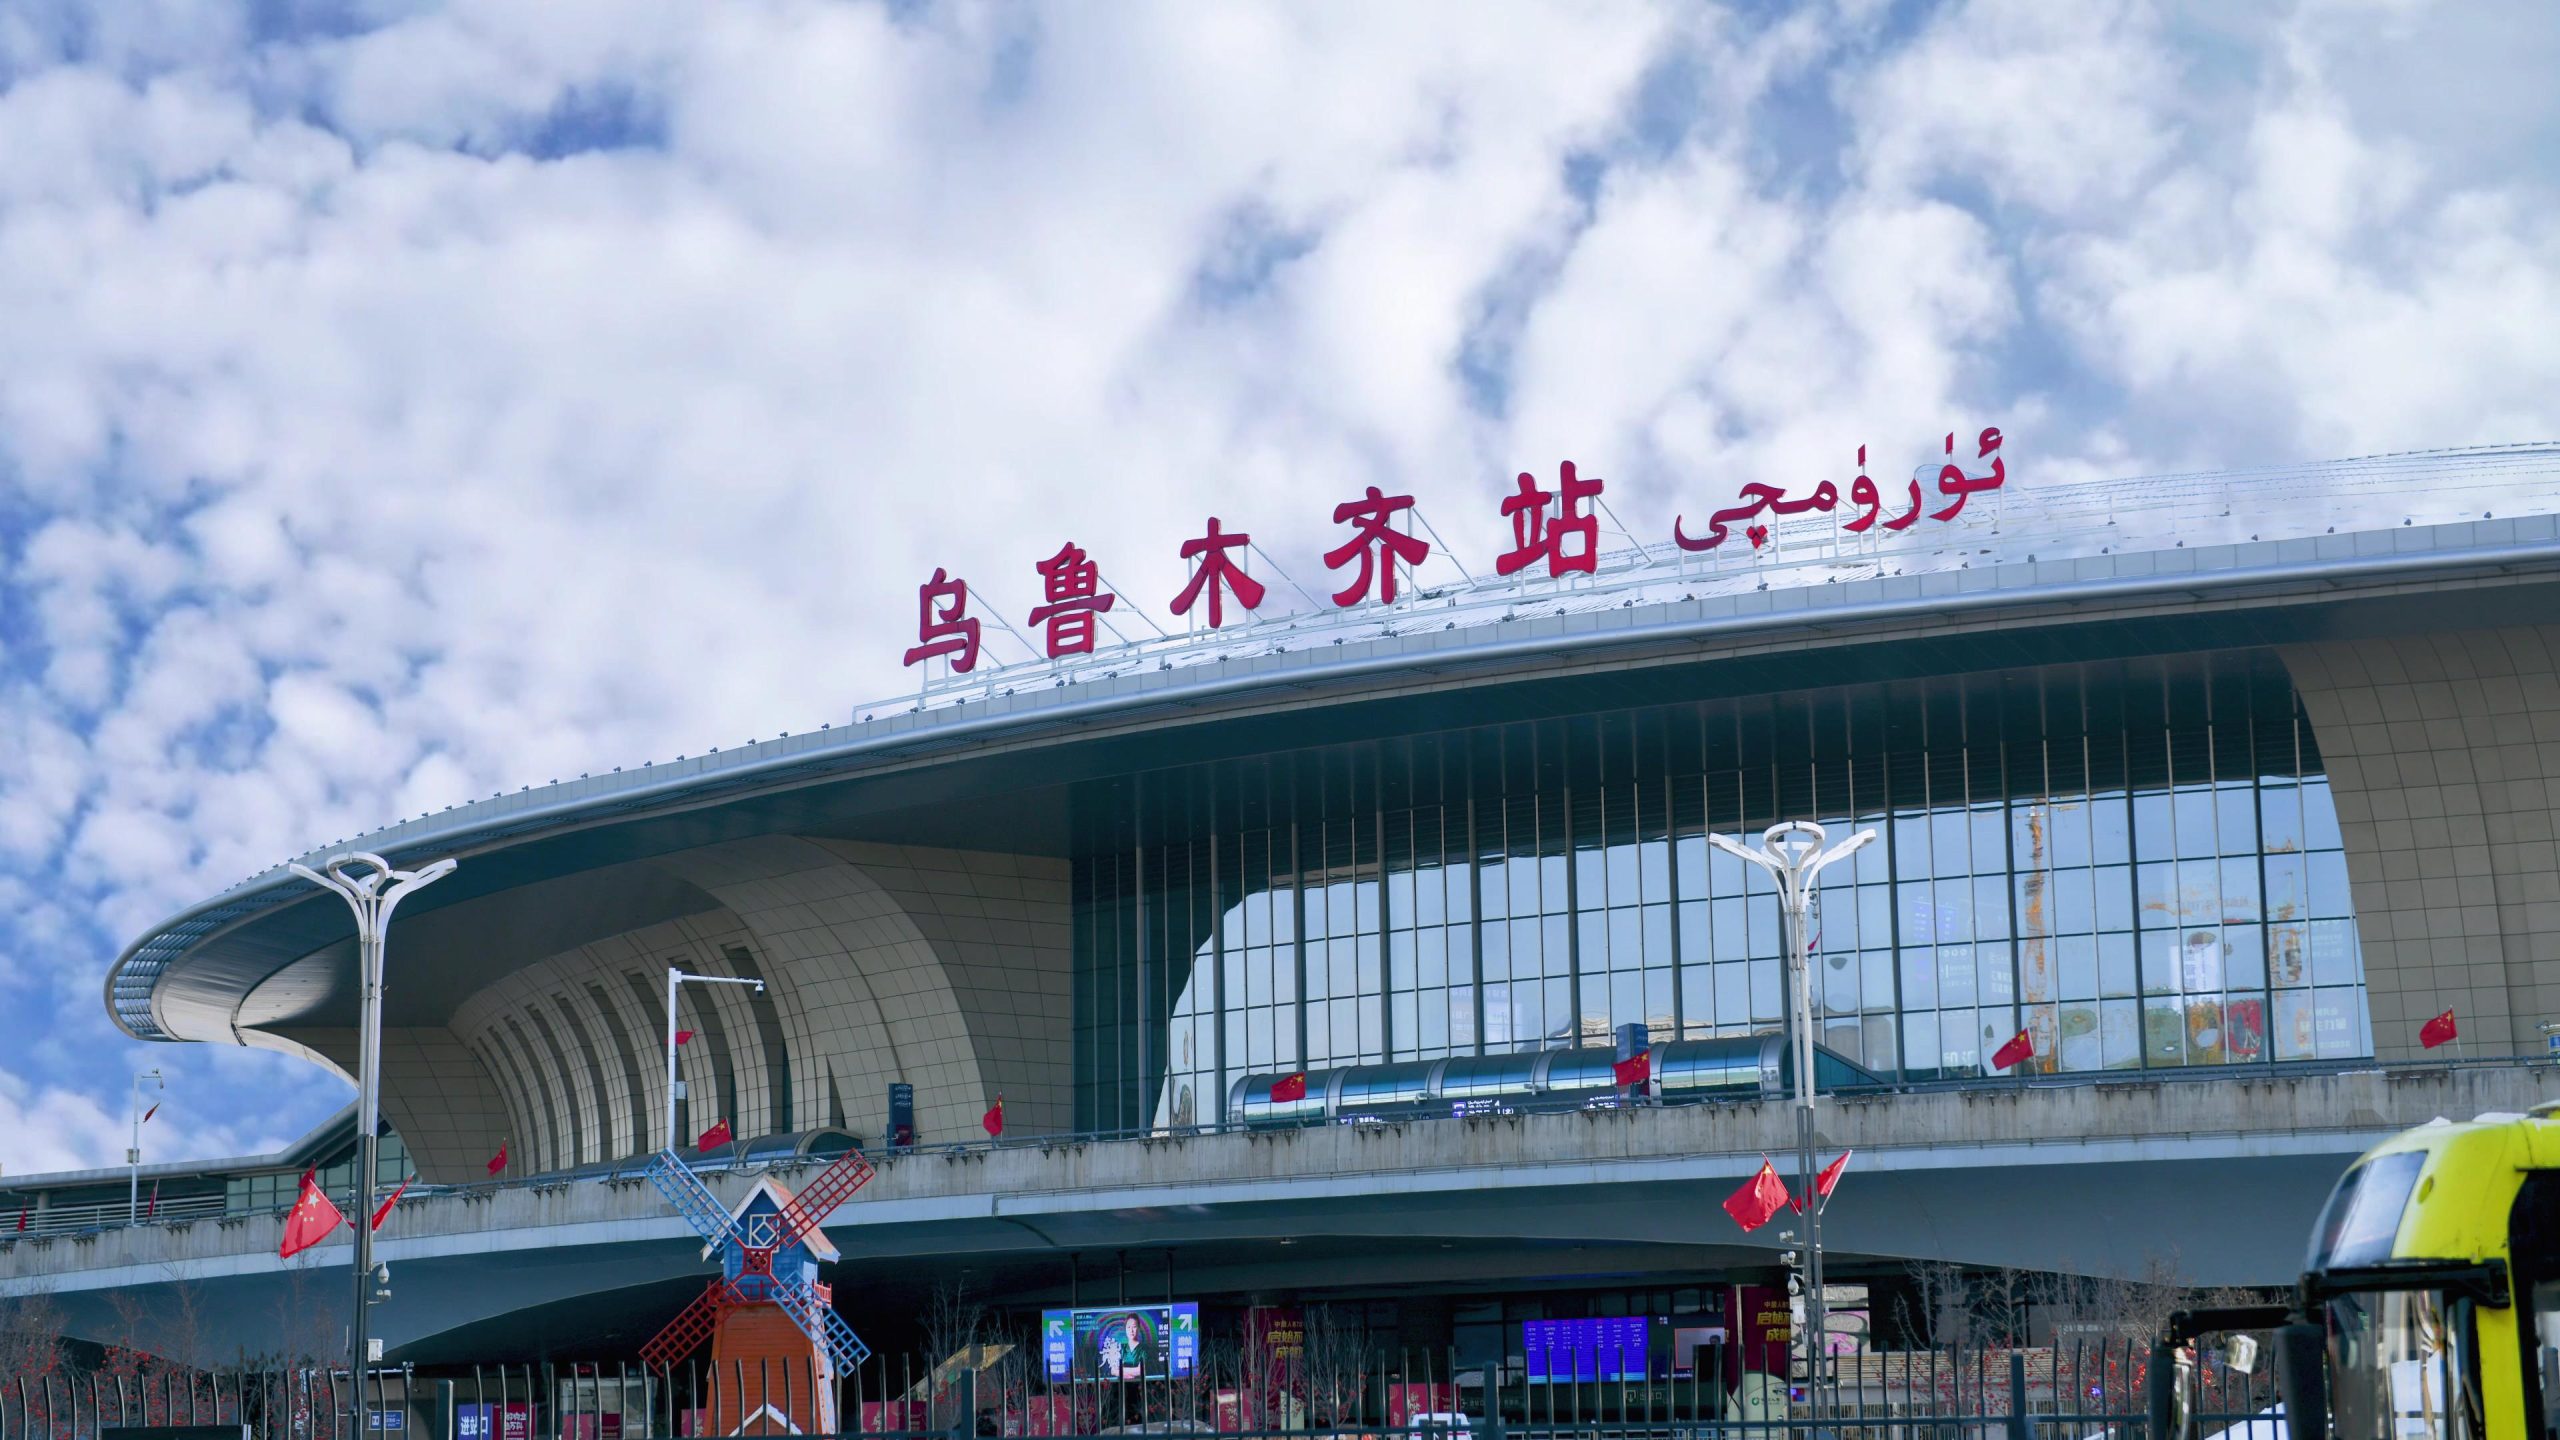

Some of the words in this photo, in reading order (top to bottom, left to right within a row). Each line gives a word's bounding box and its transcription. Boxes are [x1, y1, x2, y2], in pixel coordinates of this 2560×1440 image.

[903, 460, 1605, 673] 乌鲁木齐站
